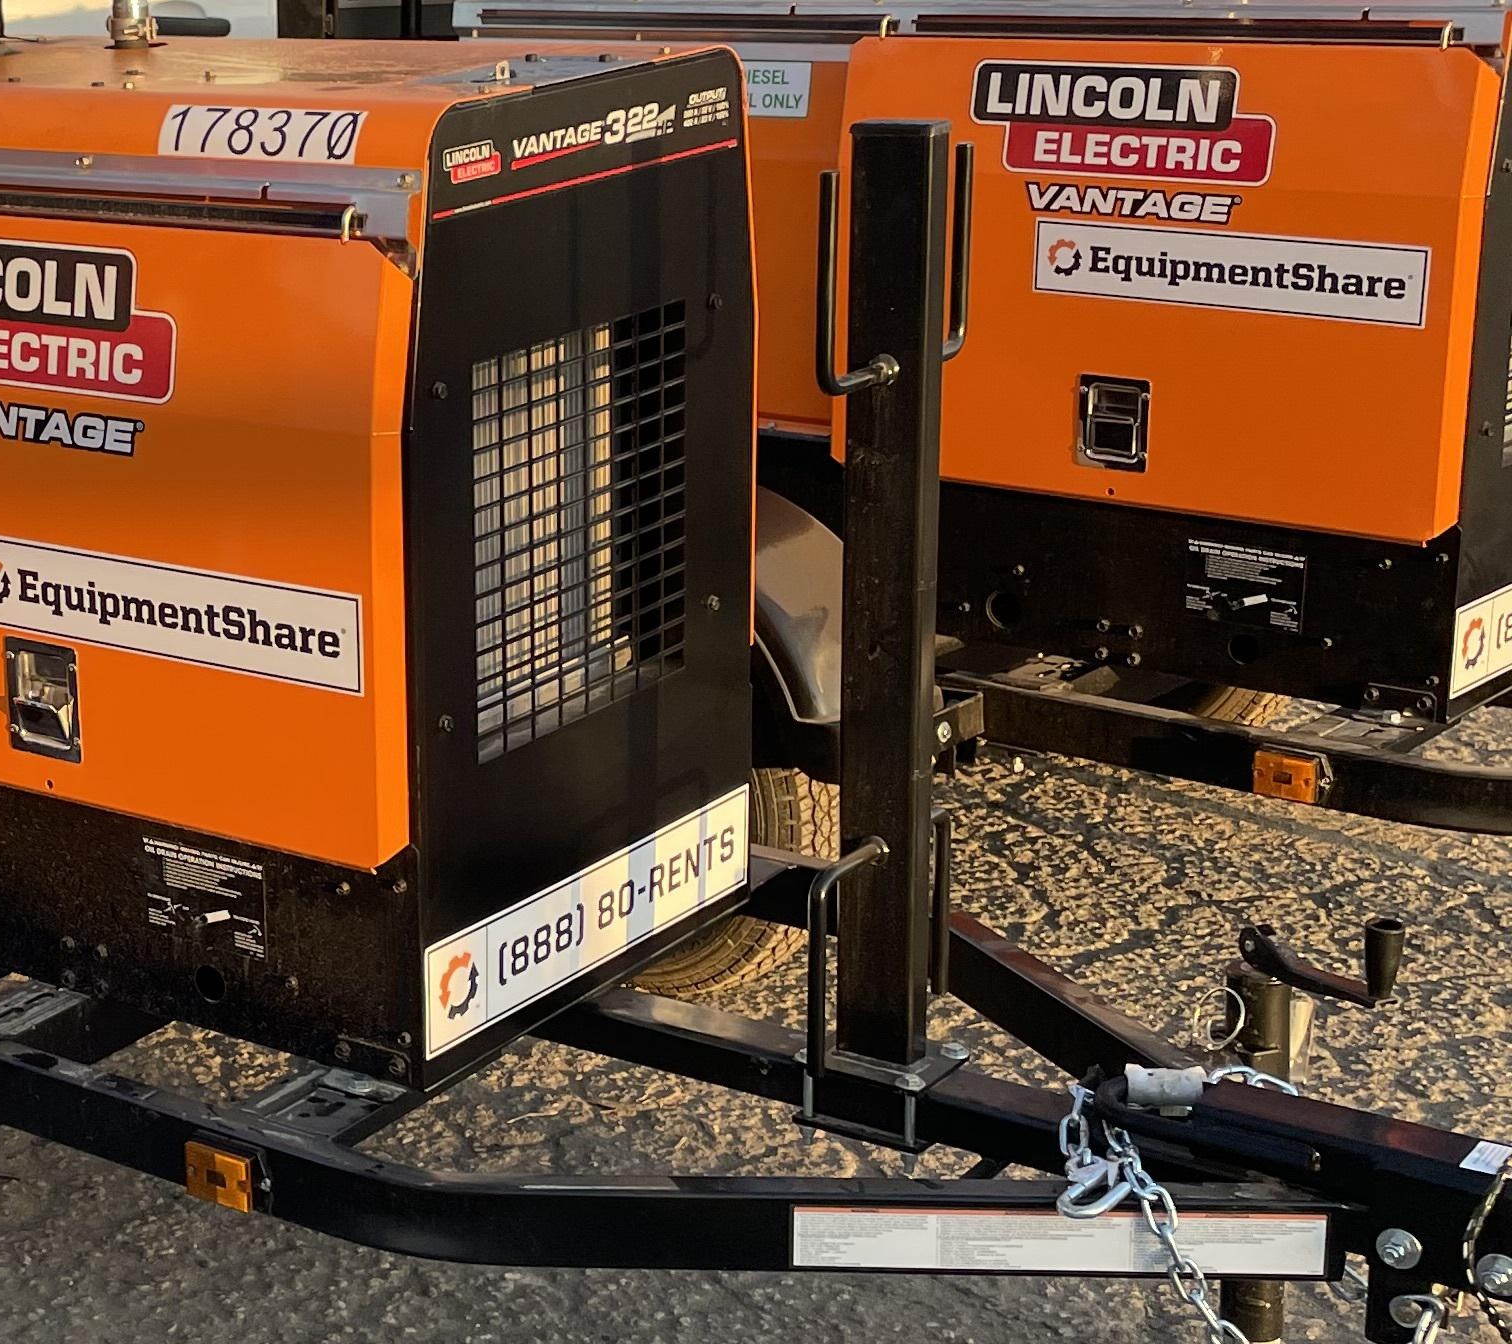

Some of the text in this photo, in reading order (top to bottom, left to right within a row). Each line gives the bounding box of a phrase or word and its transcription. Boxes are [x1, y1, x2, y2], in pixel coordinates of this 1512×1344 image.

[762, 93, 804, 109] ONLY
[986, 71, 1222, 124] LINCOLN
[170, 107, 364, 161] 178370
[446, 143, 491, 167] LINCOLN
[511, 120, 603, 159] VANTAGE
[603, 102, 660, 145] 322
[1033, 130, 1243, 173] ELECTRIC
[1026, 182, 1232, 223] VANTAGE
[1088, 245, 1408, 301] EquipmentShare
[17, 568, 341, 659] EquipmentShare
[498, 825, 735, 986] (888) 80-RENTS
